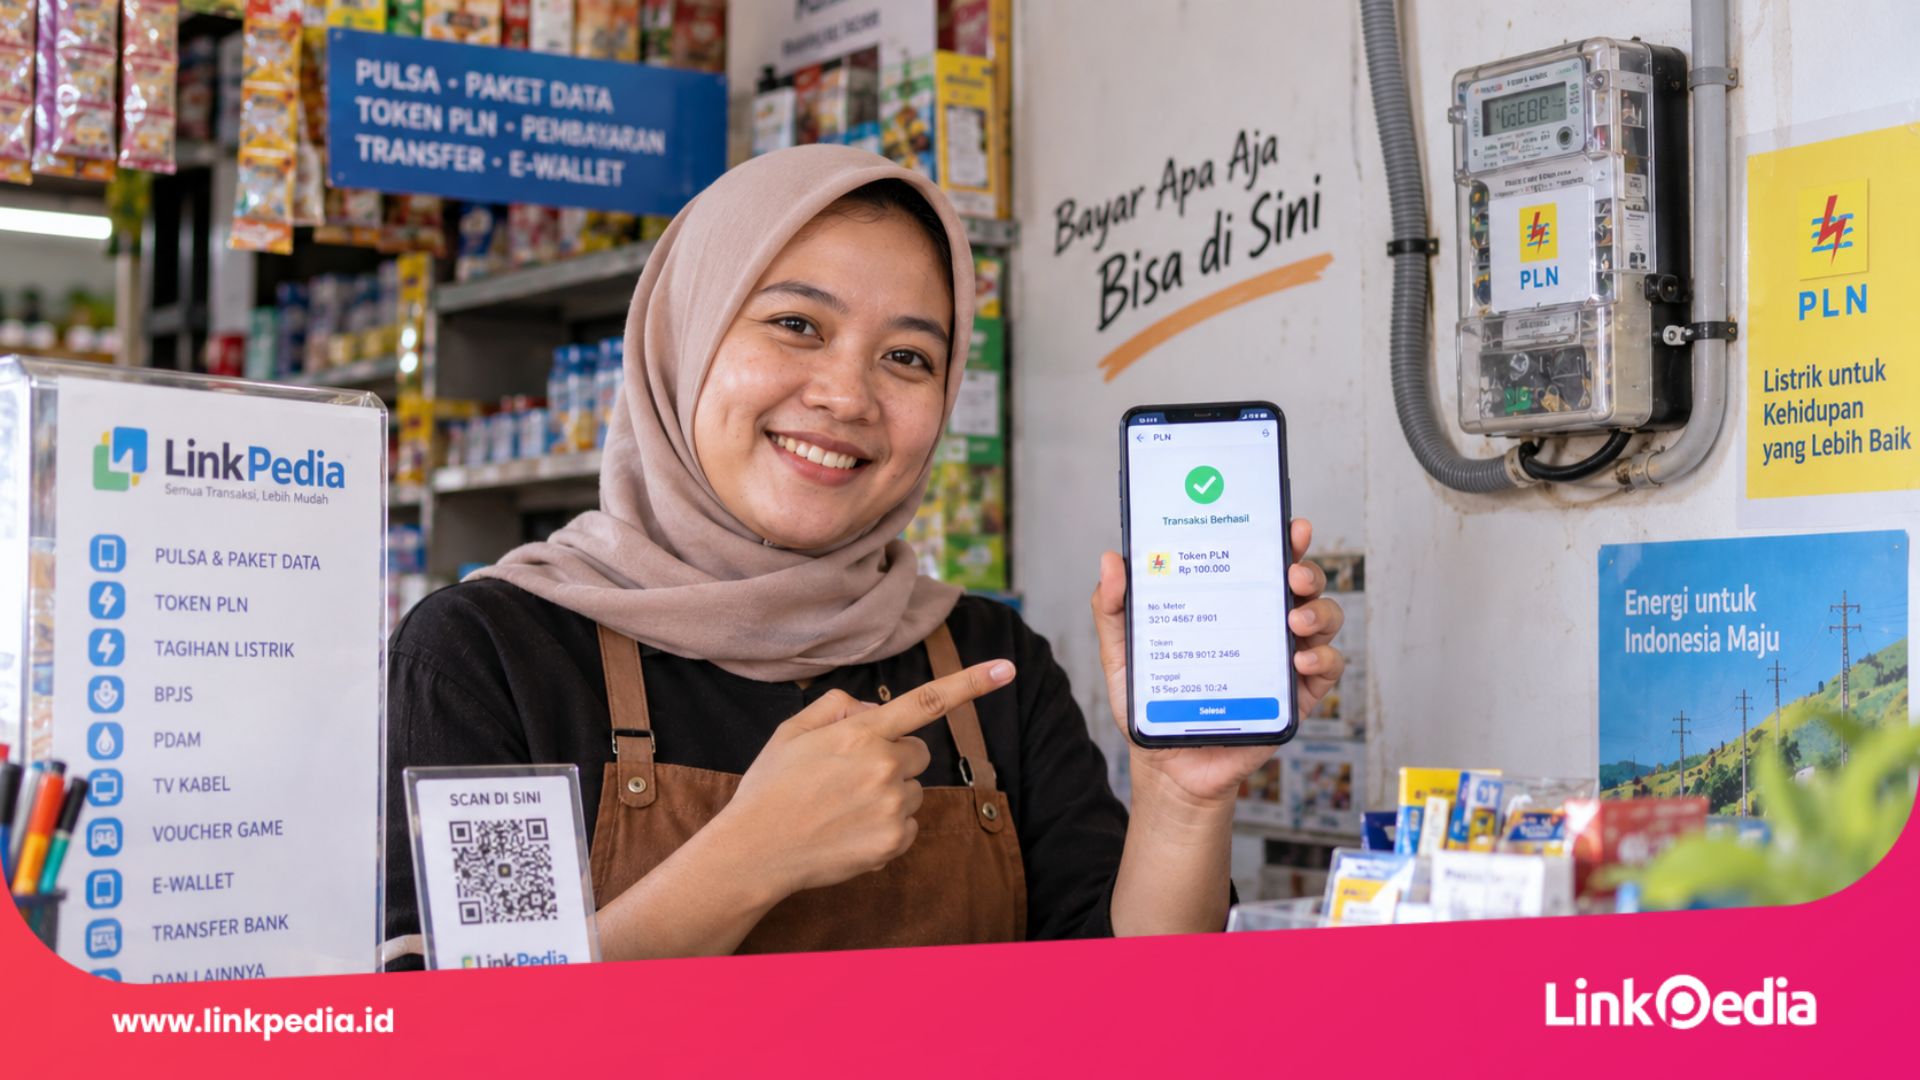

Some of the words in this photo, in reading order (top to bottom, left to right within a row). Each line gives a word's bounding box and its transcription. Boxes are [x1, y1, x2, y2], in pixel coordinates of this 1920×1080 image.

[355, 58, 441, 94] PULSA
[465, 71, 546, 105] PAKET
[550, 81, 613, 114] DATA
[355, 96, 442, 132] TOKEN
[450, 108, 497, 137] PLN
[522, 114, 666, 156] PEMBAYARAN
[355, 133, 485, 173] TRANSFER
[510, 150, 625, 187] E-WALLET
[1054, 184, 1145, 256] Bayar
[1156, 157, 1215, 218] Apa
[1227, 129, 1278, 191] Aja
[1097, 249, 1183, 332] Bisa
[1201, 209, 1232, 275] di
[1249, 174, 1321, 258] Sini
[1520, 266, 1559, 290] PLN
[1799, 283, 1867, 321] PLN
[1764, 364, 1822, 393] Listrik
[1829, 357, 1886, 386] untuk
[1764, 398, 1864, 427] Kehidupan
[1153, 433, 1171, 441] PLN
[1762, 440, 1806, 466] yang
[1812, 430, 1863, 457] Lebih
[1869, 426, 1911, 452] Baik
[165, 438, 345, 489] LinkPedia
[164, 484, 203, 497] Semua
[206, 486, 259, 502] Transaksi,
[262, 490, 291, 503] Lebih
[293, 492, 329, 505] Mudah
[1163, 515, 1208, 525] Transaksi
[1210, 514, 1249, 524] Berhasil
[155, 548, 208, 566] PULSA
[212, 551, 224, 566] &
[228, 552, 278, 569] PAKET
[282, 554, 321, 570] DATA
[1178, 551, 1207, 560] Token
[1209, 550, 1230, 559] PLN
[1178, 565, 1192, 575] Rp
[1194, 564, 1231, 573] 100.000
[155, 594, 211, 612] TOKEN
[217, 596, 248, 613] PLN
[1624, 586, 1689, 621] Energi
[1695, 584, 1757, 614] untuk
[154, 640, 229, 657] TAGIHAN
[235, 641, 295, 658] LISTRIK
[1625, 625, 1721, 653] Indonesia
[1727, 623, 1780, 659] Maju
[154, 686, 193, 703] BPJS
[1204, 683, 1228, 692] 10:24
[154, 732, 201, 748] PDAM
[153, 777, 174, 794] TV
[179, 775, 231, 793] KABEL
[449, 793, 490, 806] SCAN
[495, 792, 508, 805] DI
[513, 791, 541, 804] SINI
[152, 822, 232, 842] VOUCHER
[238, 820, 283, 838] GAME
[152, 872, 234, 894] E-WALLET
[152, 918, 239, 942] TRANSFER
[244, 914, 289, 934] BANK
